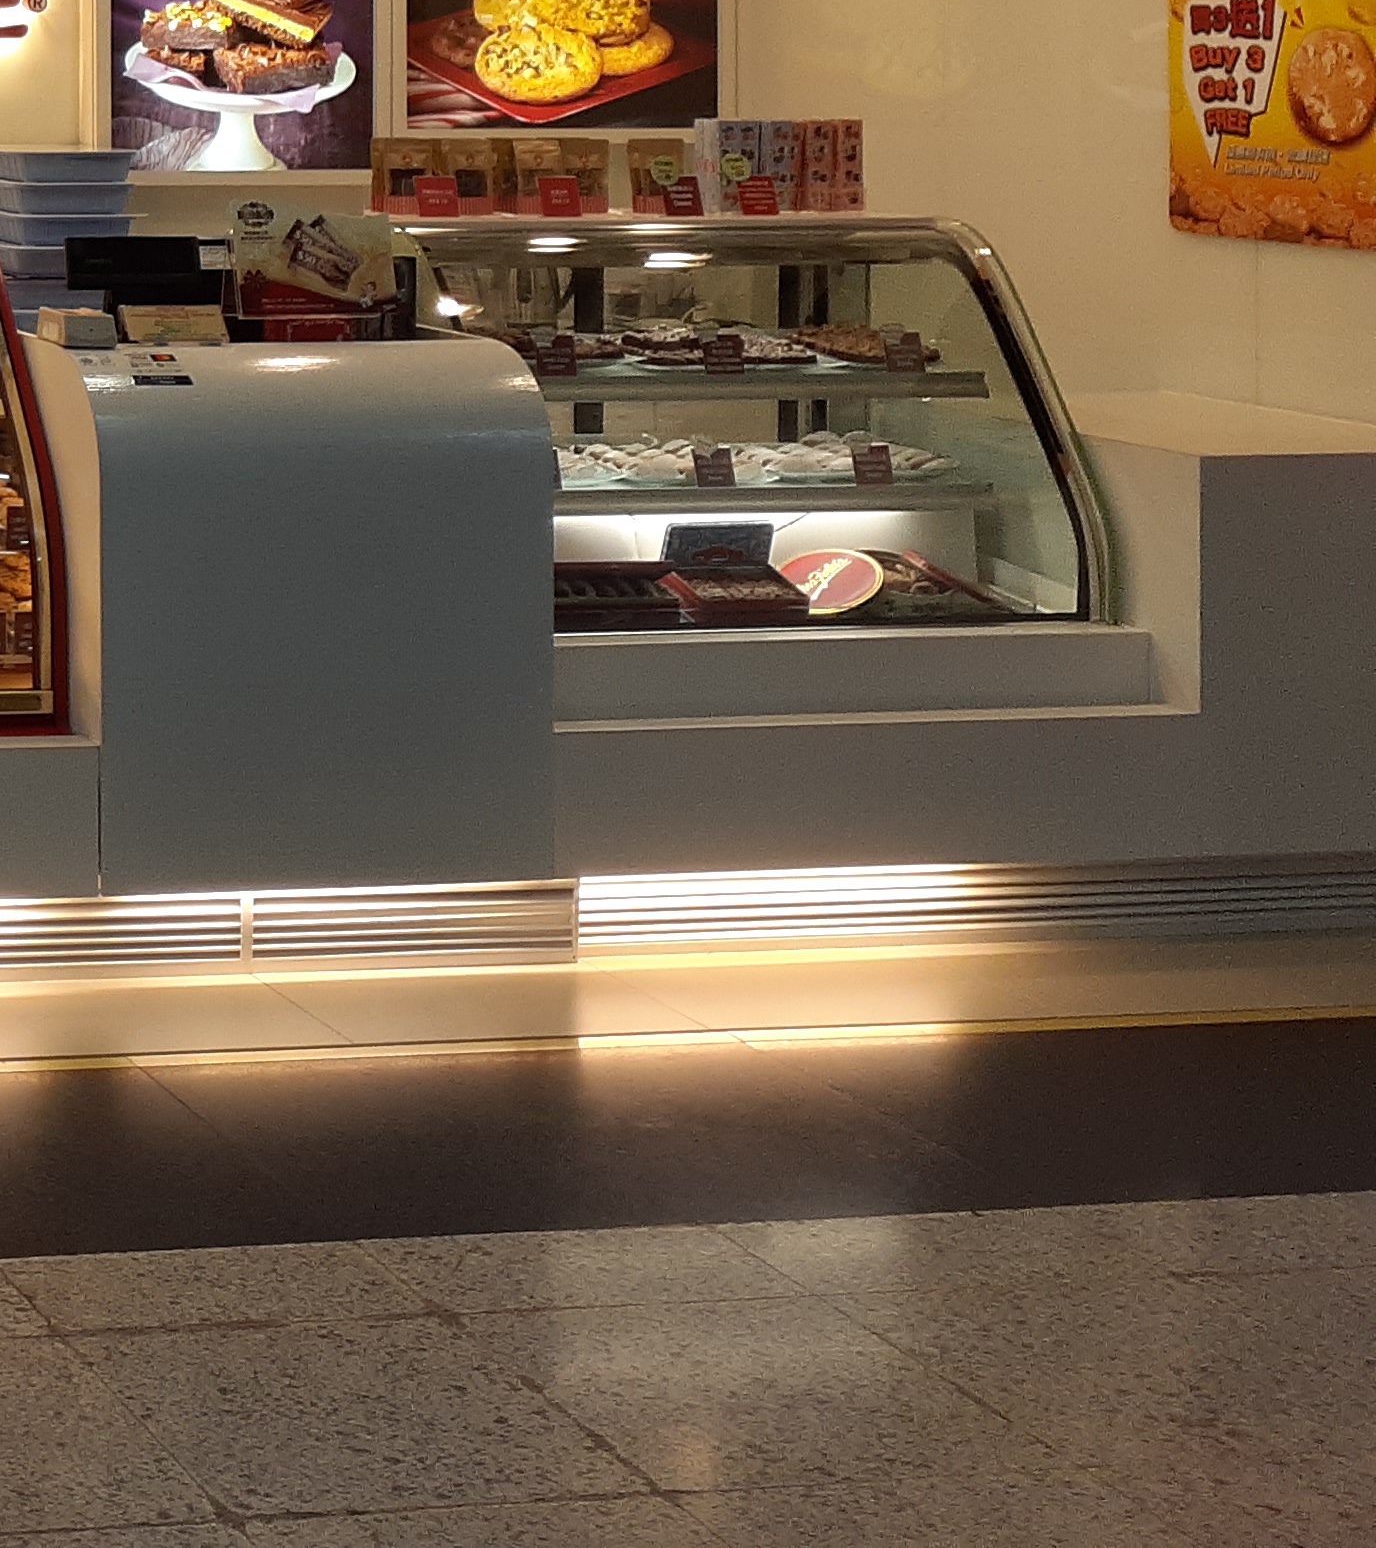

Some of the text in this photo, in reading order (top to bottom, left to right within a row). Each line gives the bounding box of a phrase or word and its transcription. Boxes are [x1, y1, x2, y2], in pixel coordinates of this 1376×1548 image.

[1190, 44, 1265, 73] Buy 3
[1199, 76, 1255, 105] Get 1
[1205, 108, 1251, 138] FREE
